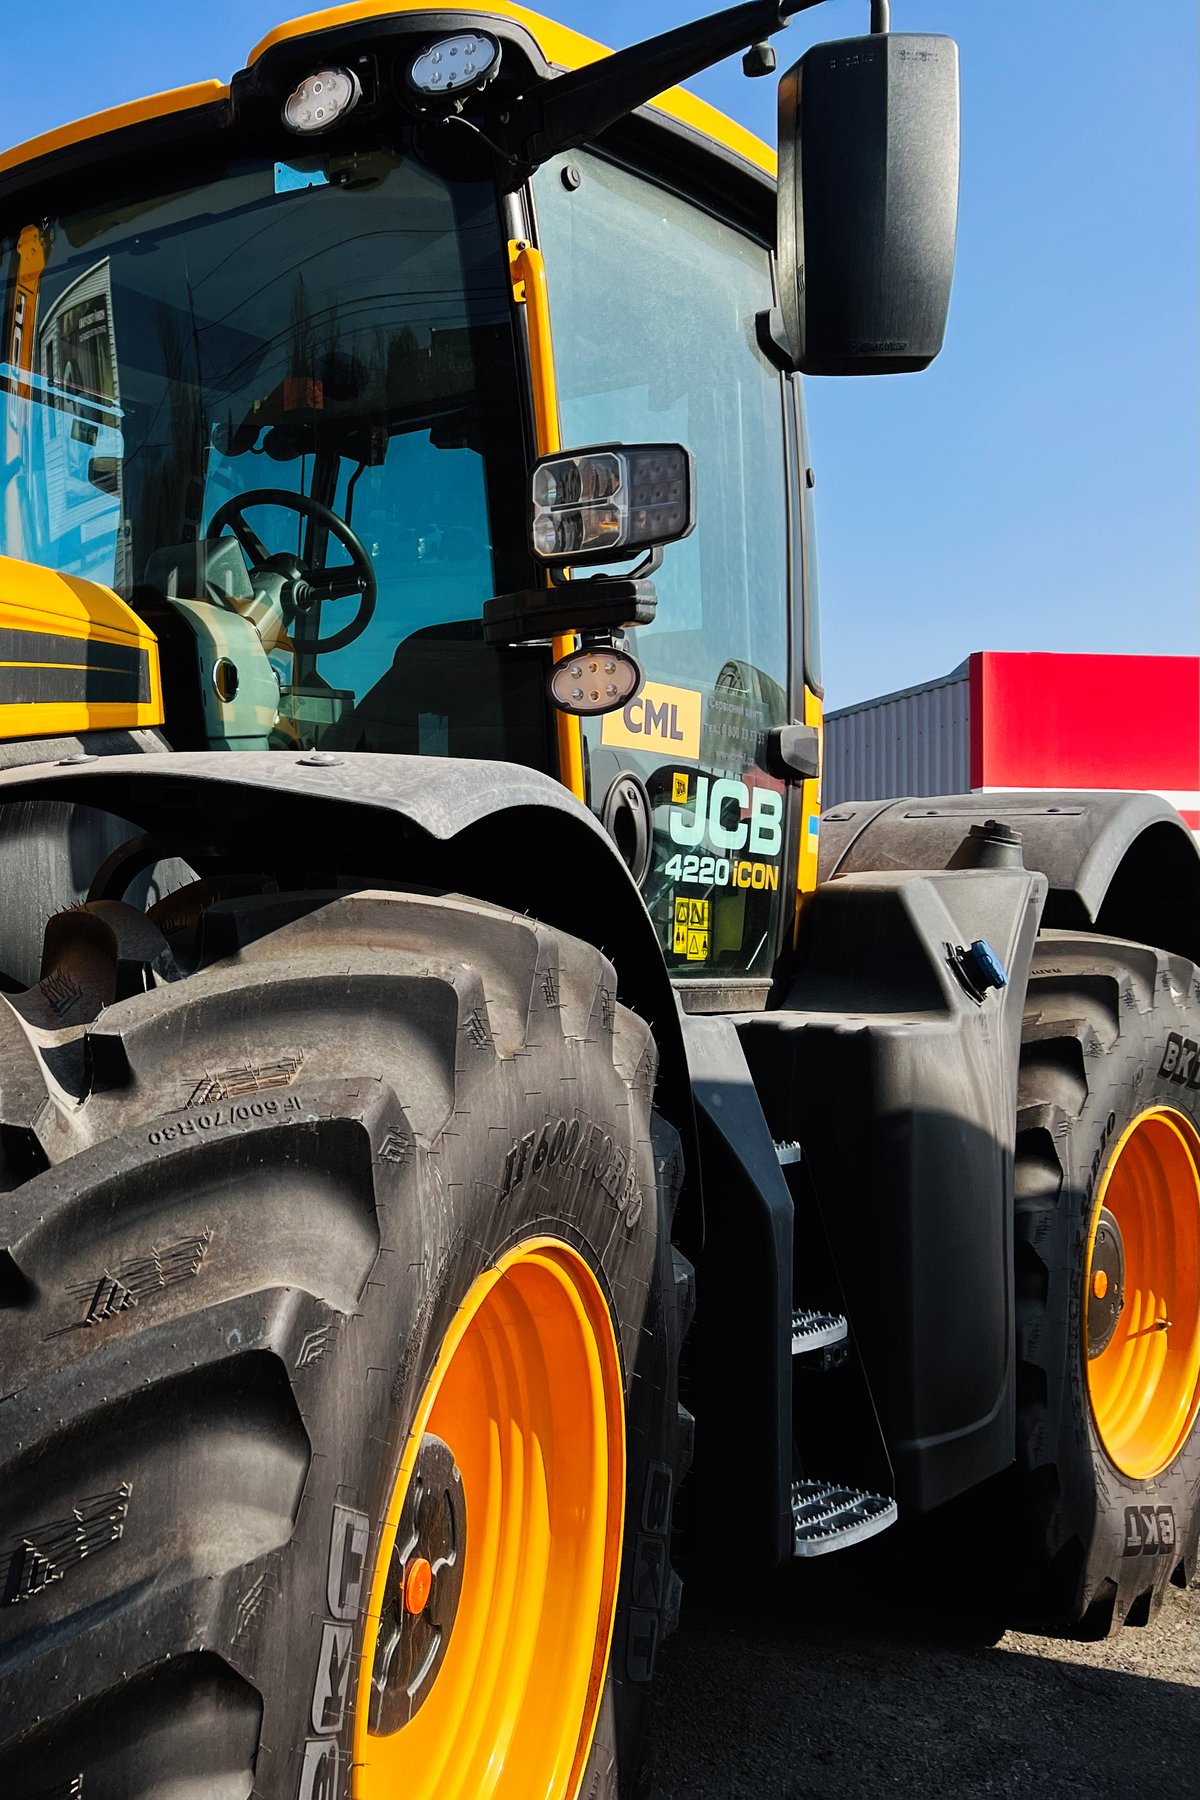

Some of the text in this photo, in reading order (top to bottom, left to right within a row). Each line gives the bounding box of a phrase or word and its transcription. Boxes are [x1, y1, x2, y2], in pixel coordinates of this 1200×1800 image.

[623, 698, 684, 741] CML
[669, 776, 783, 857] JCB
[664, 854, 779, 891] 4220 iCON
[1162, 1039, 1200, 1083] BK
[1126, 1511, 1175, 1548] BKT
